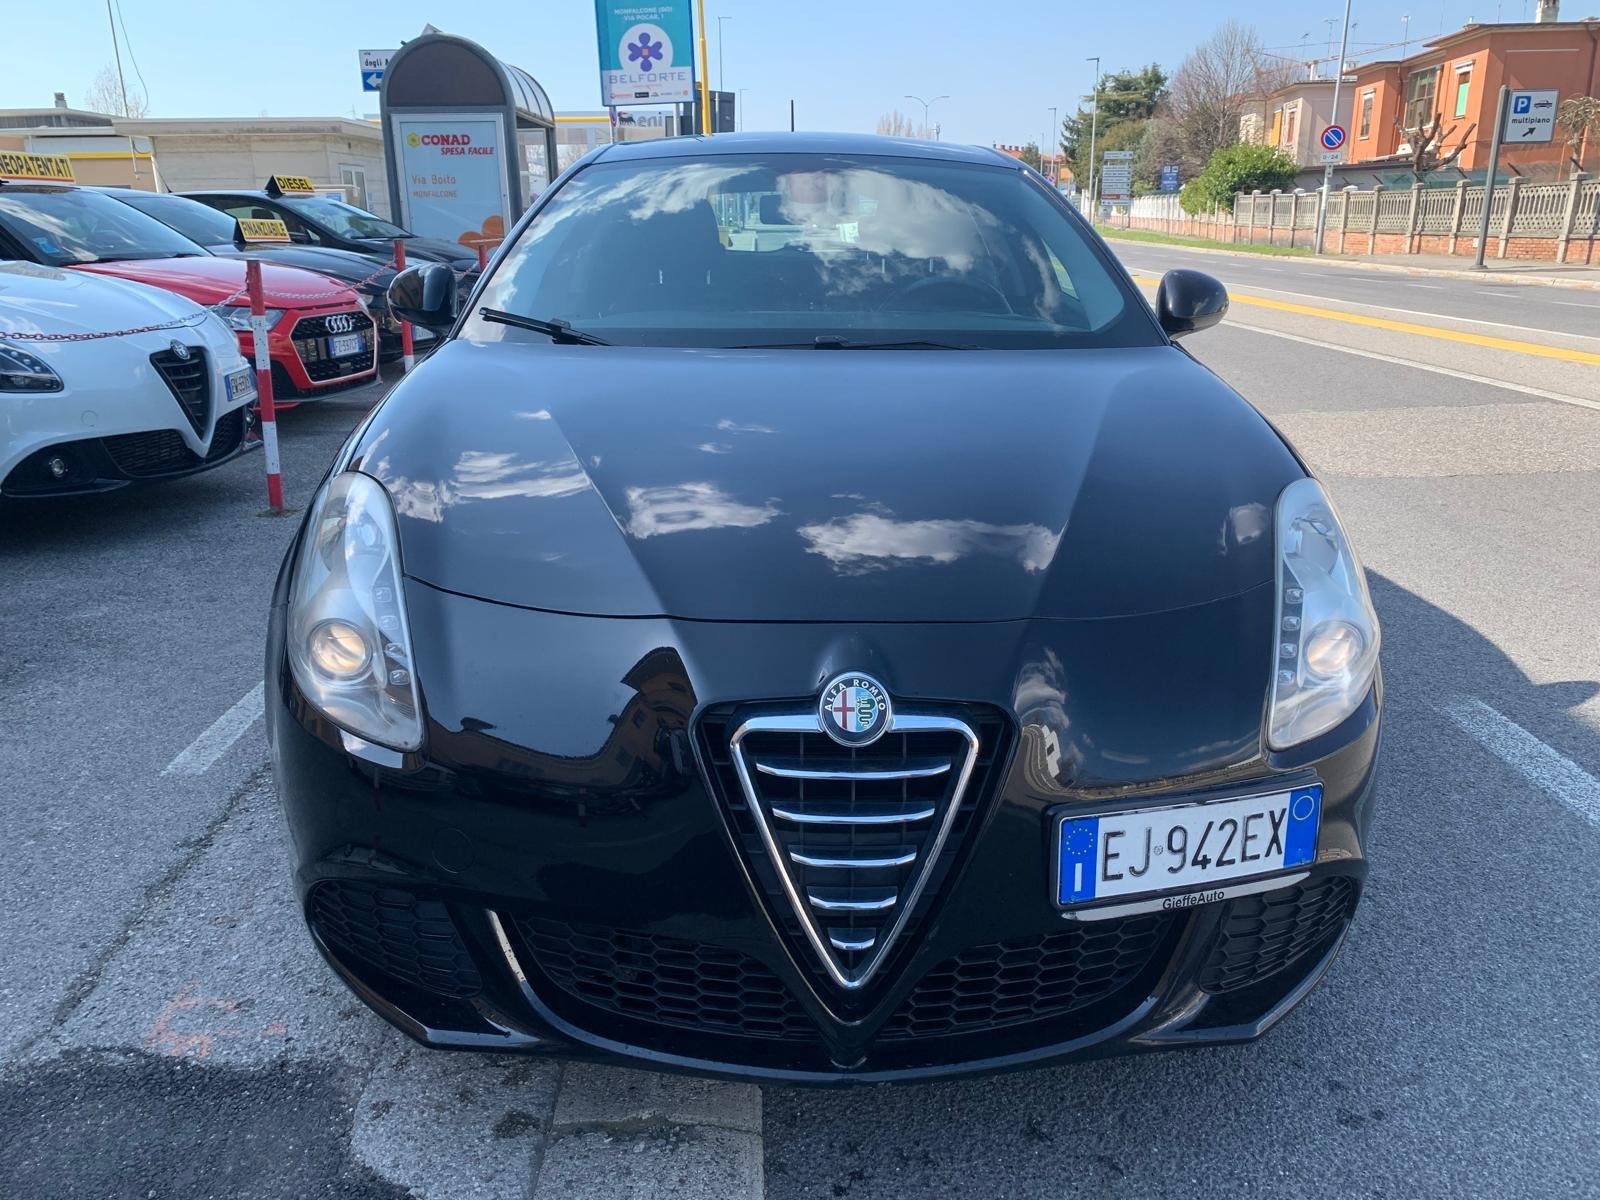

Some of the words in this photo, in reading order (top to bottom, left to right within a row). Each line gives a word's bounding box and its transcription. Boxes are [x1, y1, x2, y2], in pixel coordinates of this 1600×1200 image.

[608, 72, 686, 84] BELFORTE
[1516, 98, 1529, 112] P
[637, 111, 663, 127] eni
[1511, 117, 1551, 125] multipiano
[421, 134, 471, 146] CONAD
[440, 147, 465, 156] SPESA
[468, 146, 495, 155] FACILE
[276, 177, 313, 190] DIESEL
[412, 175, 427, 185] Via
[431, 174, 457, 185] Boito
[413, 190, 458, 198] MONFALCONE
[240, 221, 287, 236] FINANZIABILE
[824, 682, 847, 712] ALFA
[853, 679, 886, 711] ROMEO
[1102, 826, 1152, 882] EJ
[1167, 807, 1287, 874] 942EX
[1162, 888, 1225, 910] GieffeAuto
